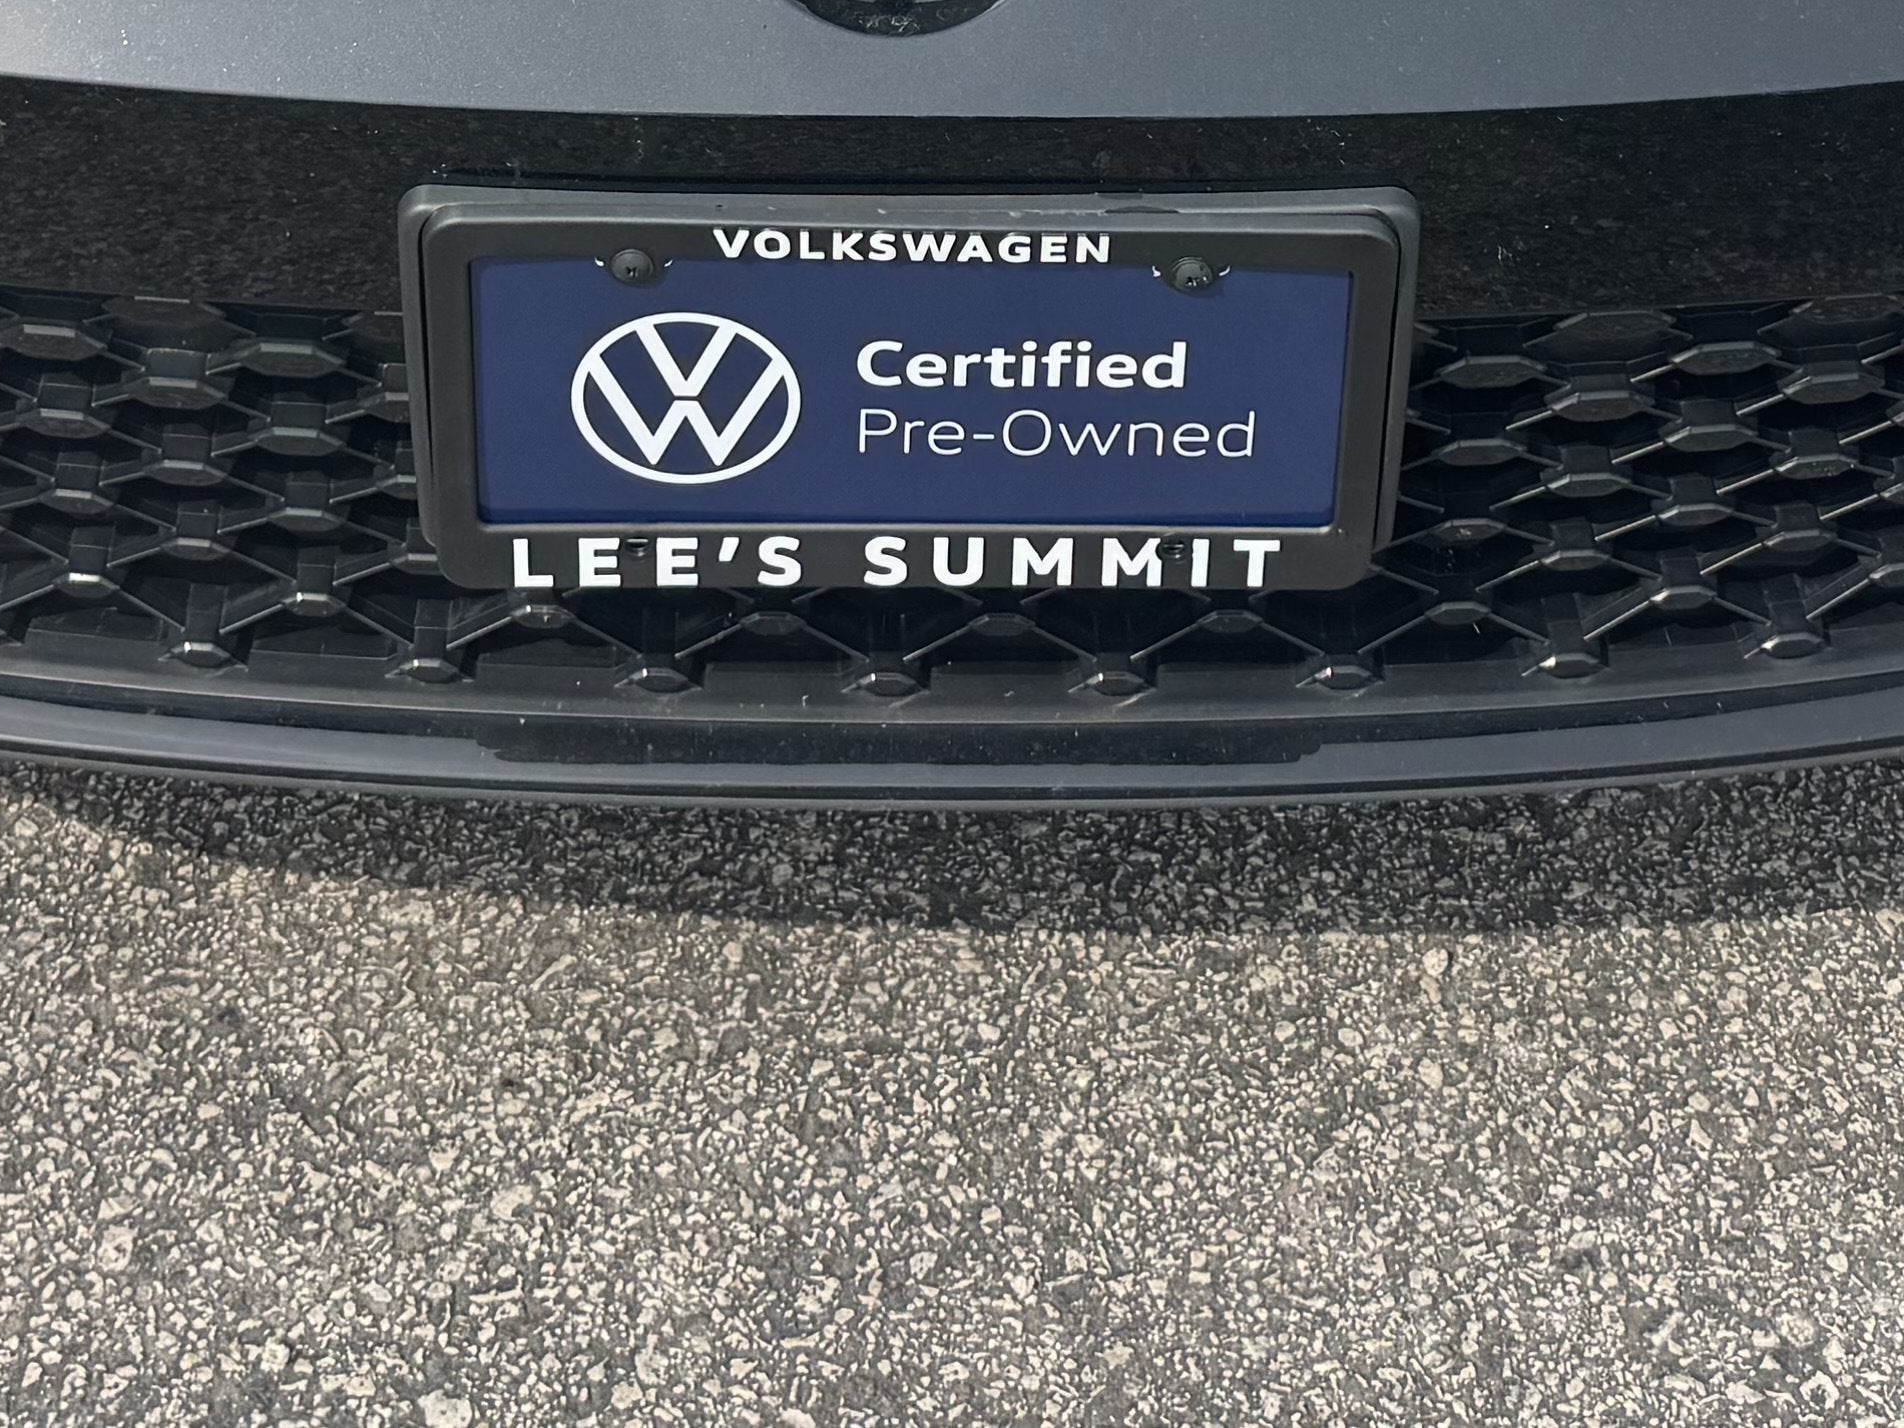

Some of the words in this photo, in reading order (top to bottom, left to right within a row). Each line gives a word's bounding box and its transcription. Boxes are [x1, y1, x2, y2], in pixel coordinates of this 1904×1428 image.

[712, 227, 1111, 264] VOLKSWAGEN
[571, 313, 800, 484] VW
[858, 341, 1186, 388] Certified
[860, 409, 1254, 456] Pre-Owned
[513, 536, 801, 587] LEE'S
[863, 536, 1284, 588] SUMMIT
